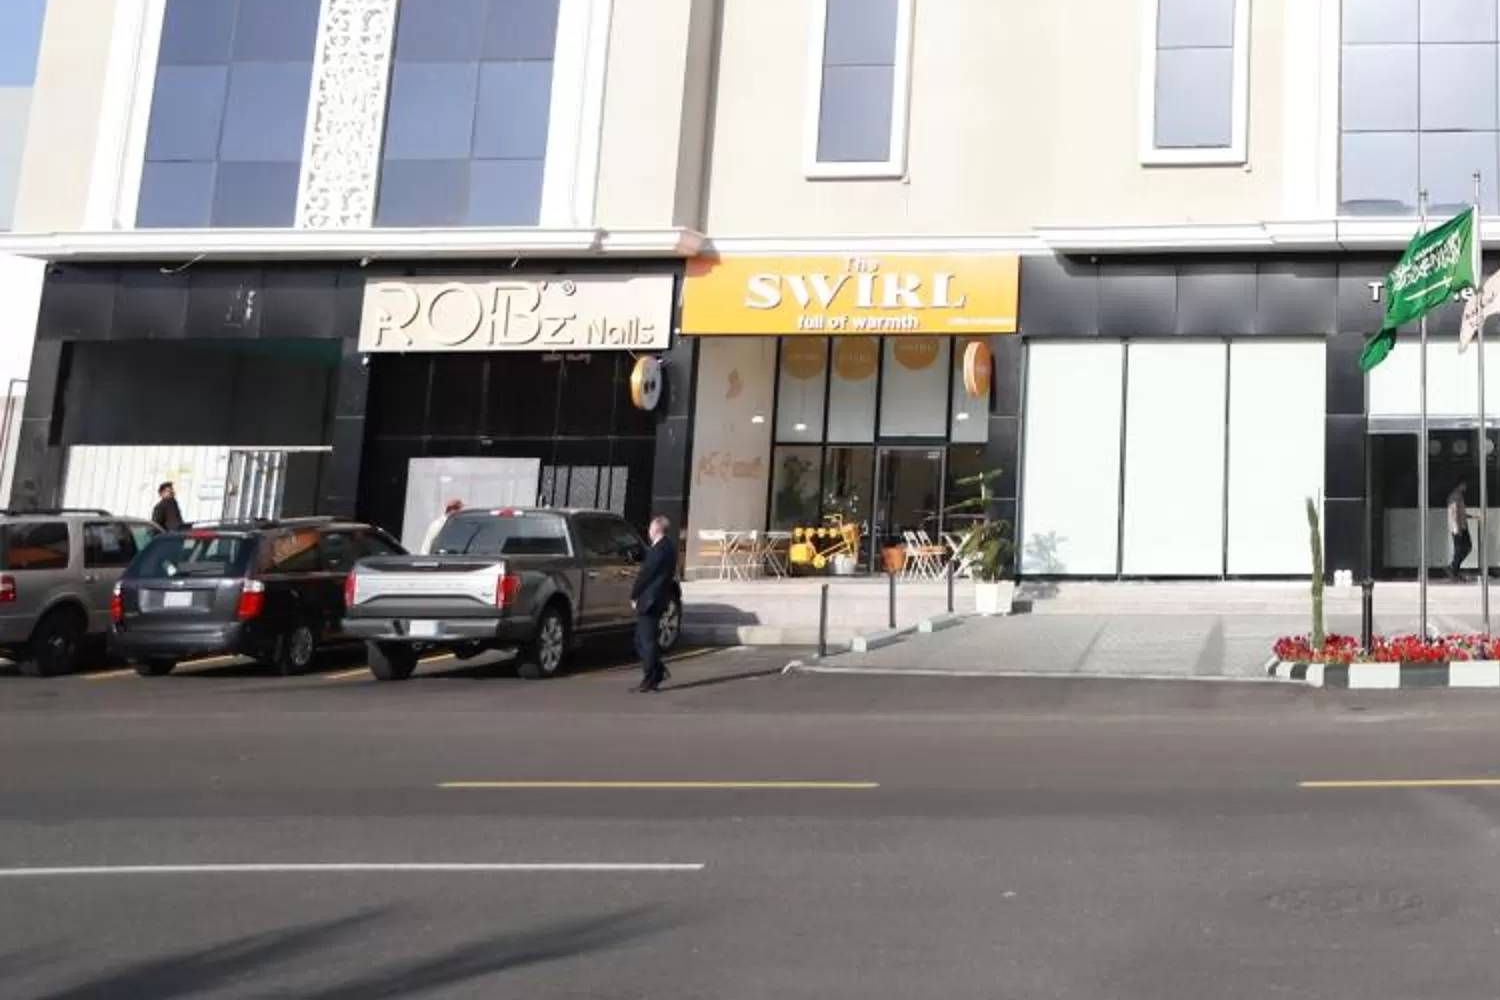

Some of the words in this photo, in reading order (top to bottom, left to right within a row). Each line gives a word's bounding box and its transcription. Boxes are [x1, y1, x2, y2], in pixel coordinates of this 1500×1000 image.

[743, 272, 967, 310] SWIRL
[585, 315, 656, 346] Nails
[797, 315, 824, 331] full
[830, 315, 850, 331] of
[852, 314, 921, 331] warmth
